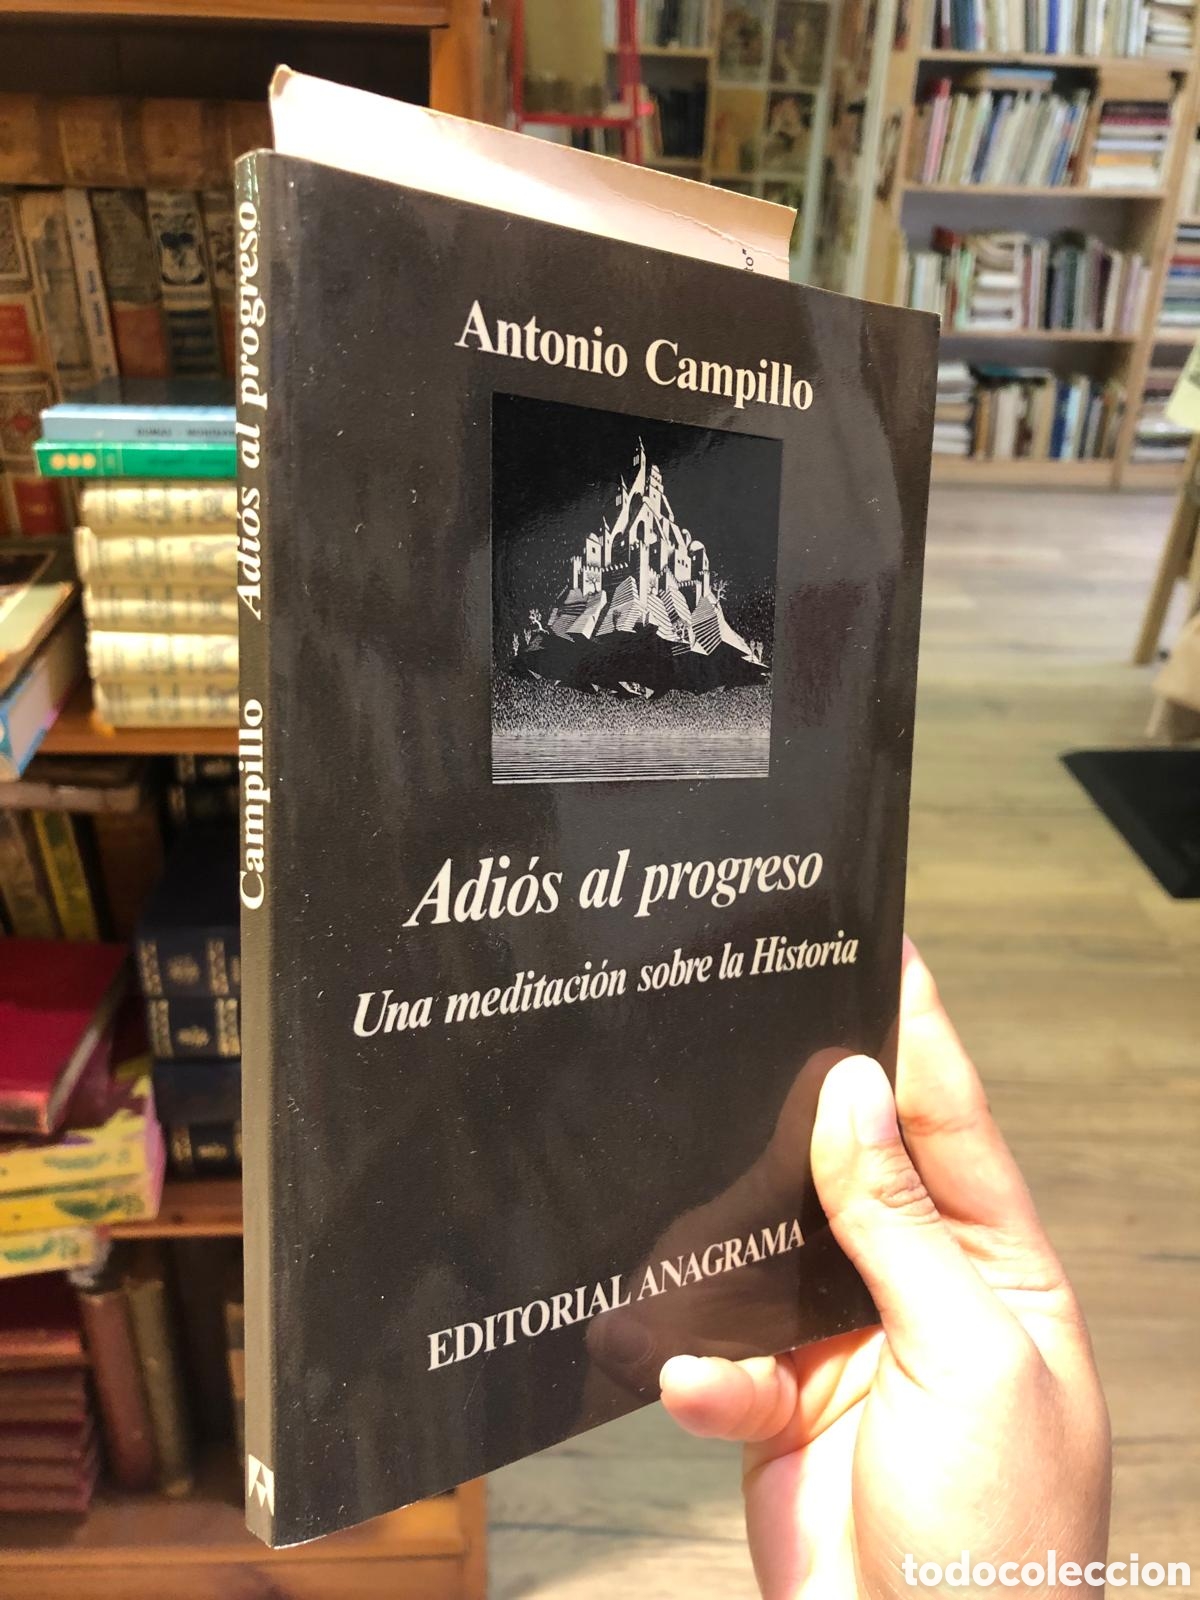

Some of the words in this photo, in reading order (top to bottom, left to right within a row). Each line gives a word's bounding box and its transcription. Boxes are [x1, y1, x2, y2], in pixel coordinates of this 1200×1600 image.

[238, 201, 267, 410] progreso
[454, 299, 628, 378] Antonio
[645, 339, 814, 410] Campillo
[236, 422, 261, 469] al
[236, 486, 261, 621] Adiós
[237, 698, 271, 910] Campillo
[402, 855, 563, 927] Adiós
[578, 848, 631, 909] al
[633, 851, 823, 918] progreso
[353, 989, 432, 1037] Una
[444, 959, 627, 1024] meditación
[637, 947, 712, 993] sobre
[718, 941, 744, 981] la
[750, 929, 859, 976] Historia
[427, 1273, 632, 1371] EDITORIAL
[636, 1218, 805, 1301] ANAGRAMA
